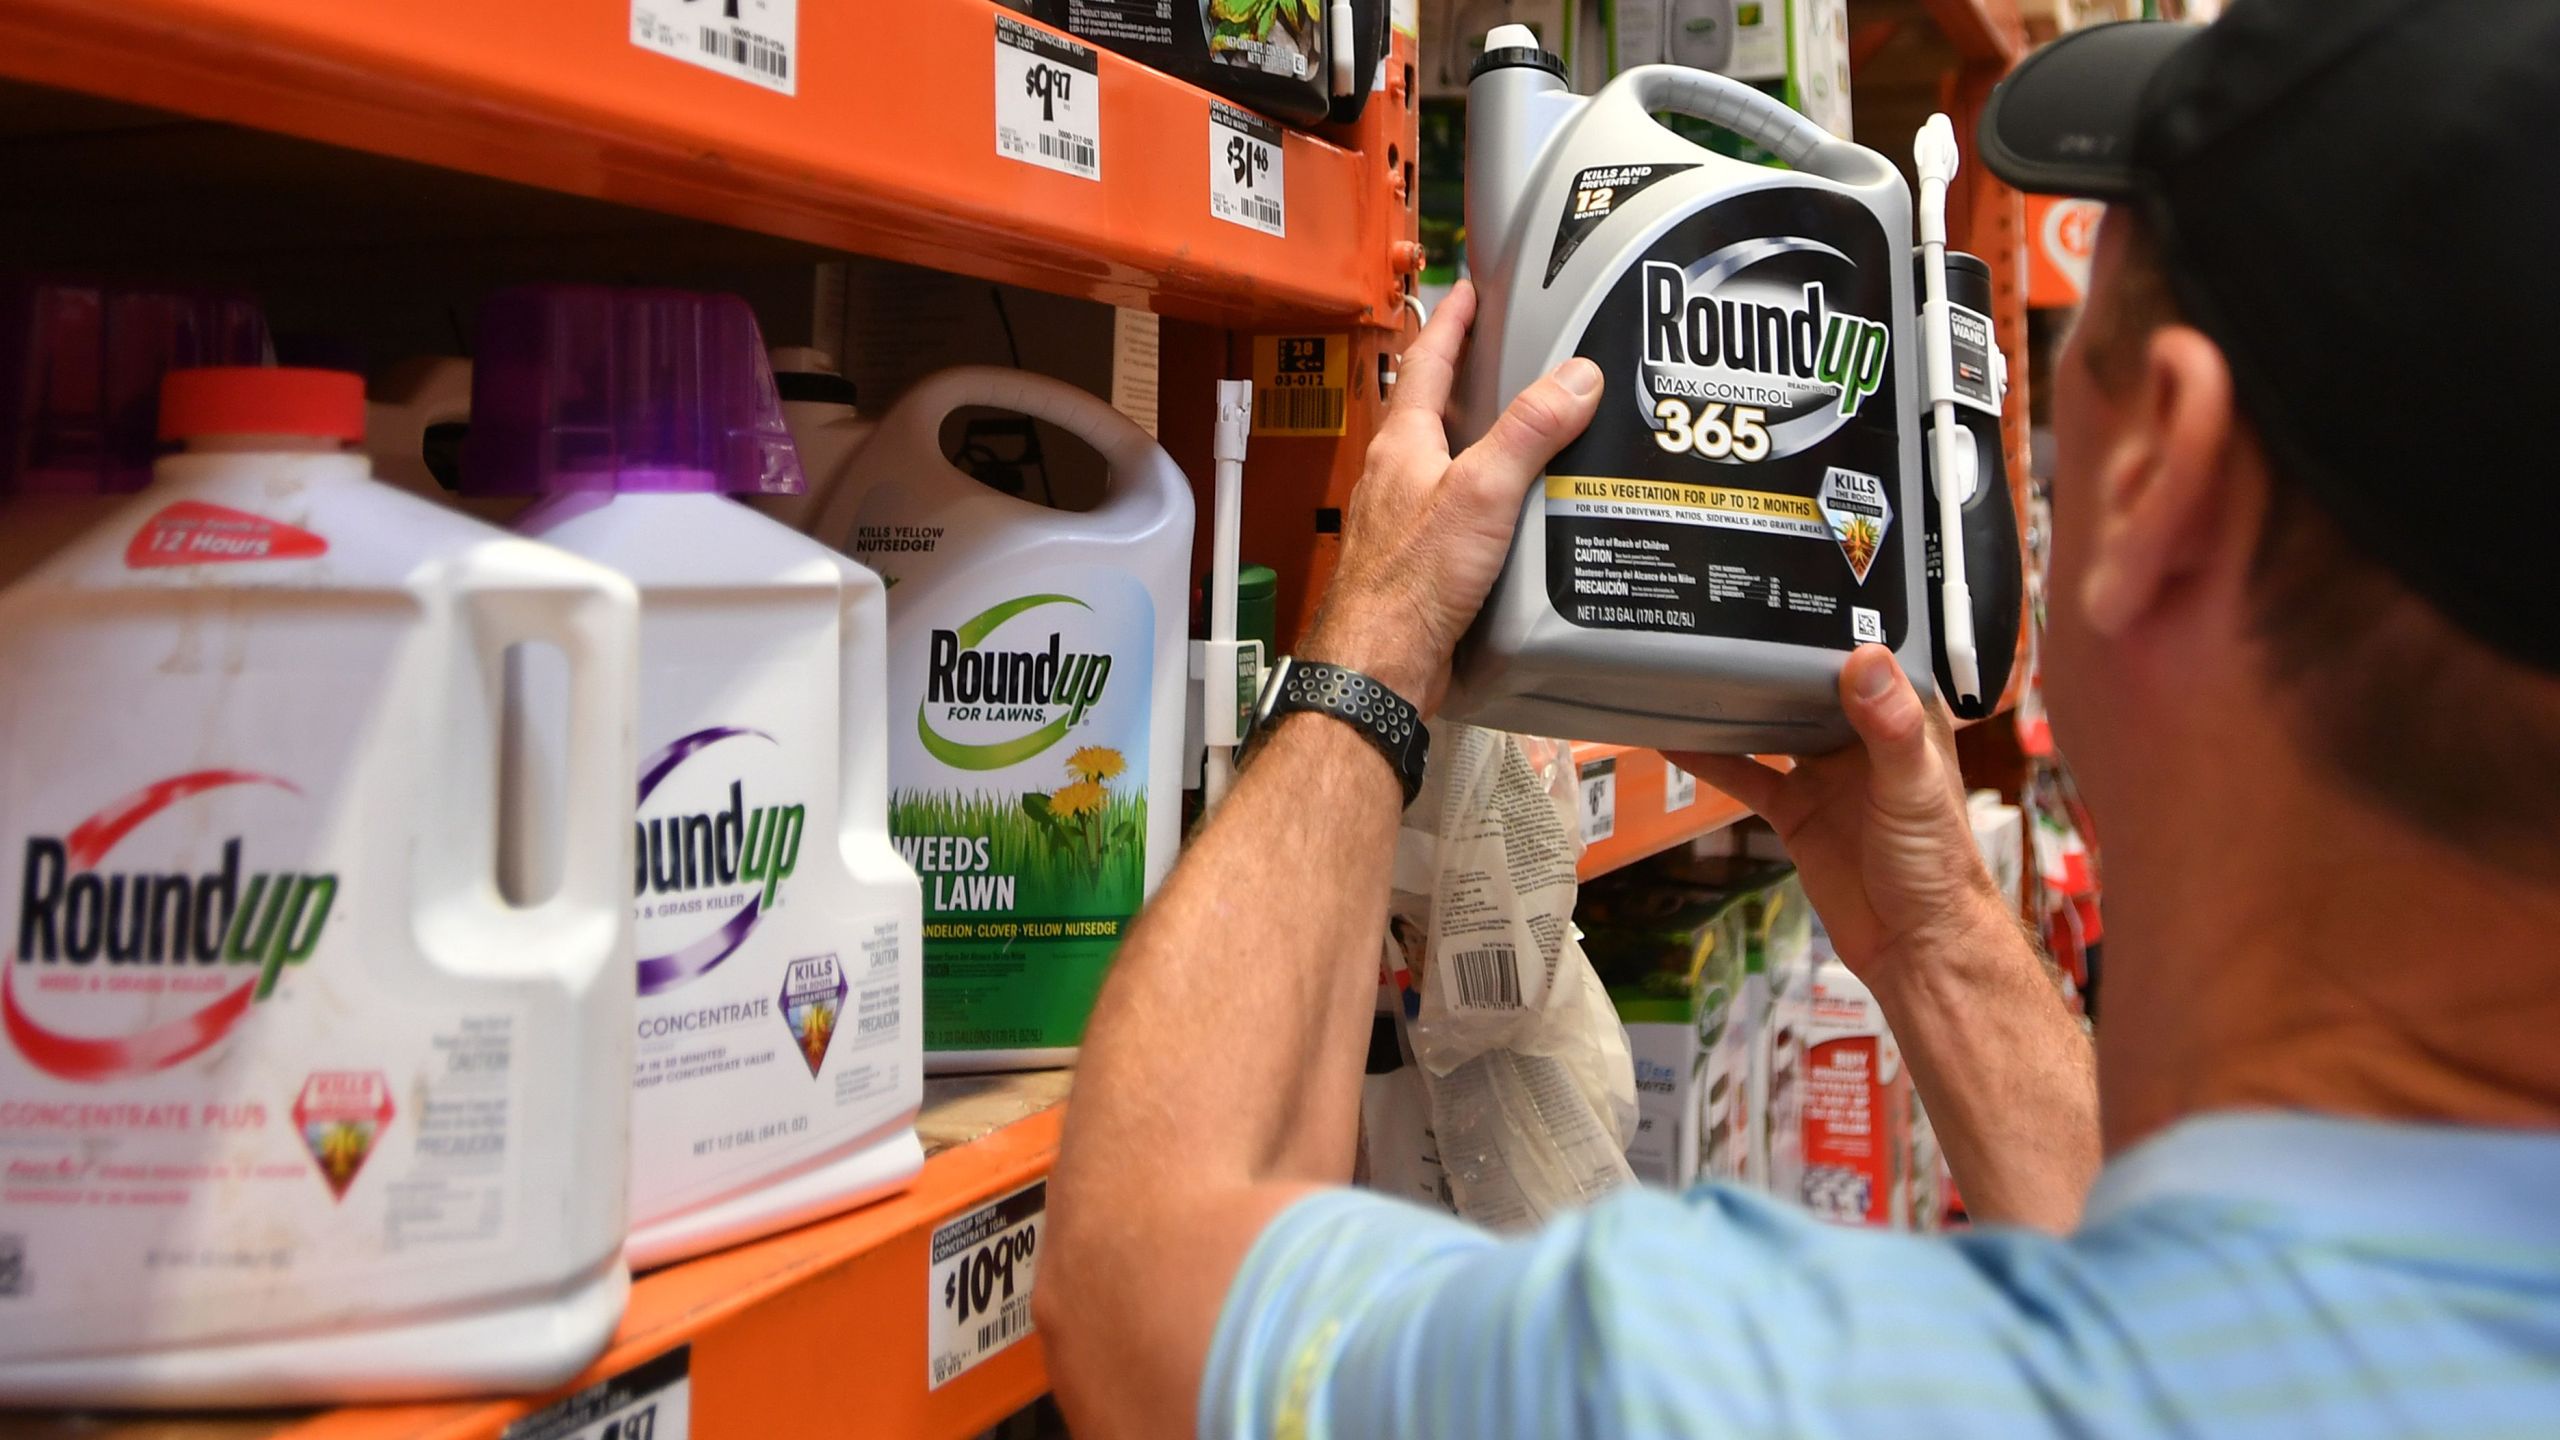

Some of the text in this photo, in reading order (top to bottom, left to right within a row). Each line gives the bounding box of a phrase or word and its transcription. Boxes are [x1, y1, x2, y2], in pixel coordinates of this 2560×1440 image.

[998, 16, 1023, 35] ORTHO
[1579, 177, 1631, 190] PREVENTS
[1582, 168, 1618, 181] KILLS
[1619, 166, 1652, 177] AND
[1575, 187, 1615, 213] 12
[1573, 208, 1610, 220] MONTHS
[1644, 261, 1888, 415] Roundup
[1951, 321, 1986, 346] WAND
[1274, 374, 1325, 386] 03-012
[1656, 376, 1792, 408] MAX CONTROL
[1787, 381, 1810, 392] READY
[1811, 384, 1822, 393] TO
[1654, 400, 1772, 463] 365
[1834, 473, 1876, 494] KILLS
[1574, 481, 1811, 516] KILLS VEGETATION FOR UP TO 12 MONTHS
[1835, 489, 1876, 504] THE ROOTS
[1575, 503, 1823, 534] FOR USE ON DRIVEWAYS, PATIOS, SIDEWALKS AND GRAVEL AREAS
[151, 529, 270, 555] 12 Hours
[858, 526, 944, 538] KILLS YELLOW
[1575, 536, 1670, 551] Keep Out of Reach of Children
[856, 539, 936, 552] NUTSEDGE!
[1575, 548, 1612, 563] CAUTION
[1575, 566, 1604, 578] Mantener
[1604, 568, 1622, 579] Fuera
[1622, 569, 1633, 579] del
[1633, 570, 1659, 581] Alcance
[1659, 572, 1667, 582] de
[1667, 572, 1677, 583] los
[1575, 577, 1629, 596] PRECAUCIÓN
[1577, 605, 1695, 628] NET 1.33 GAL (170 FL OZ/5L)
[927, 628, 1112, 727] Roundup
[947, 706, 981, 721] FOR
[893, 836, 990, 873] WEEDS
[657, 898, 703, 918] GRASS
[706, 893, 745, 911] KILLER
[934, 875, 1015, 912] LAWN
[17, 834, 340, 1003] Roundup
[977, 923, 1018, 938] CLOVER
[1022, 922, 1063, 938] YELLOW
[1065, 921, 1118, 936] NUTSEDGE
[870, 947, 899, 968] CAUTION
[794, 958, 833, 982] KILLS
[637, 997, 769, 1039] CONCENTRATE
[666, 1055, 741, 1084] CONCENTRATE
[202, 1103, 267, 1131] PLUS
[692, 1138, 715, 1156] NET
[736, 1131, 756, 1147] GAL
[777, 1119, 789, 1136] FL
[934, 1206, 997, 1248] ROUNDUP SUPER
[934, 1226, 988, 1261] CONCENTRATE
